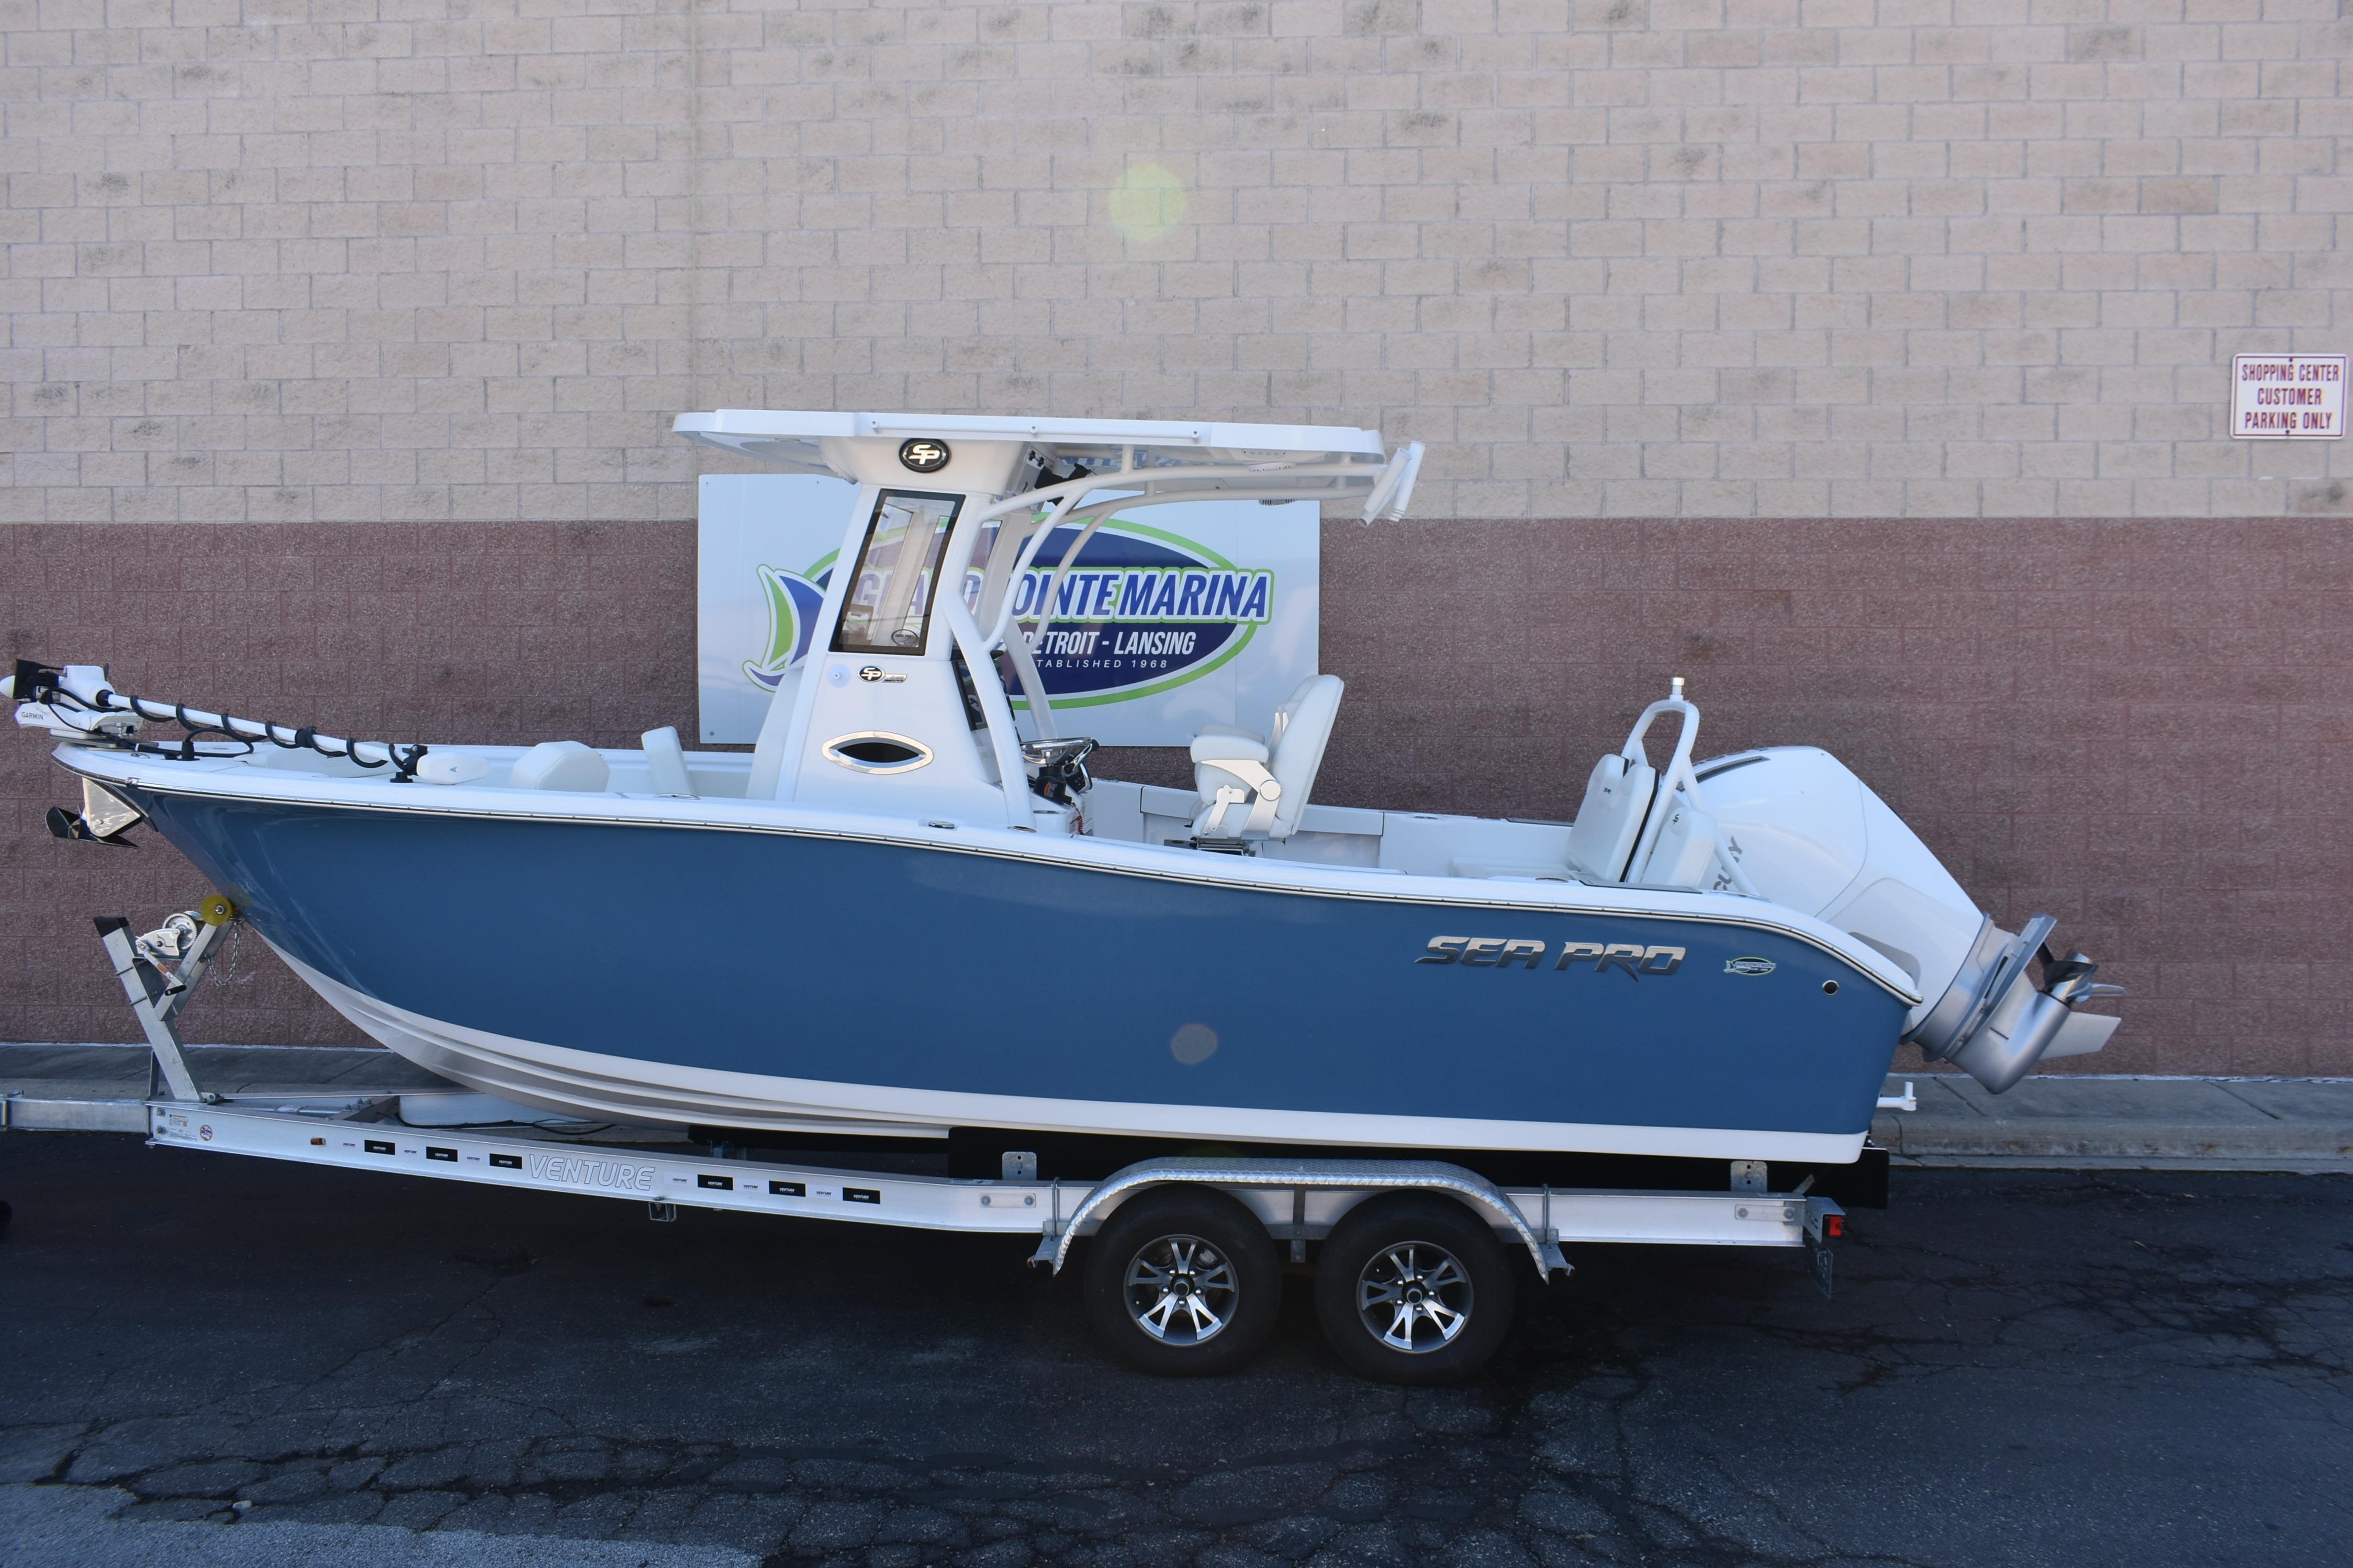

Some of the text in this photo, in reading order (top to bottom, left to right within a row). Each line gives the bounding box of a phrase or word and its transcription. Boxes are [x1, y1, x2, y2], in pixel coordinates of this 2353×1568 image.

[2242, 364, 2339, 381] SHOPPING CENTER
[2257, 388, 2322, 405] CUSTOMER
[2245, 411, 2332, 429] PARKING ONLY
[1012, 573, 1120, 616] OINTE
[1118, 574, 1267, 617] MARINA
[1114, 631, 1196, 655] LANSING
[1131, 659, 1167, 668] 1968
[21, 712, 43, 720] GARMIN
[1414, 935, 1687, 982] SEA PRO
[529, 1154, 656, 1191] VENTURE
